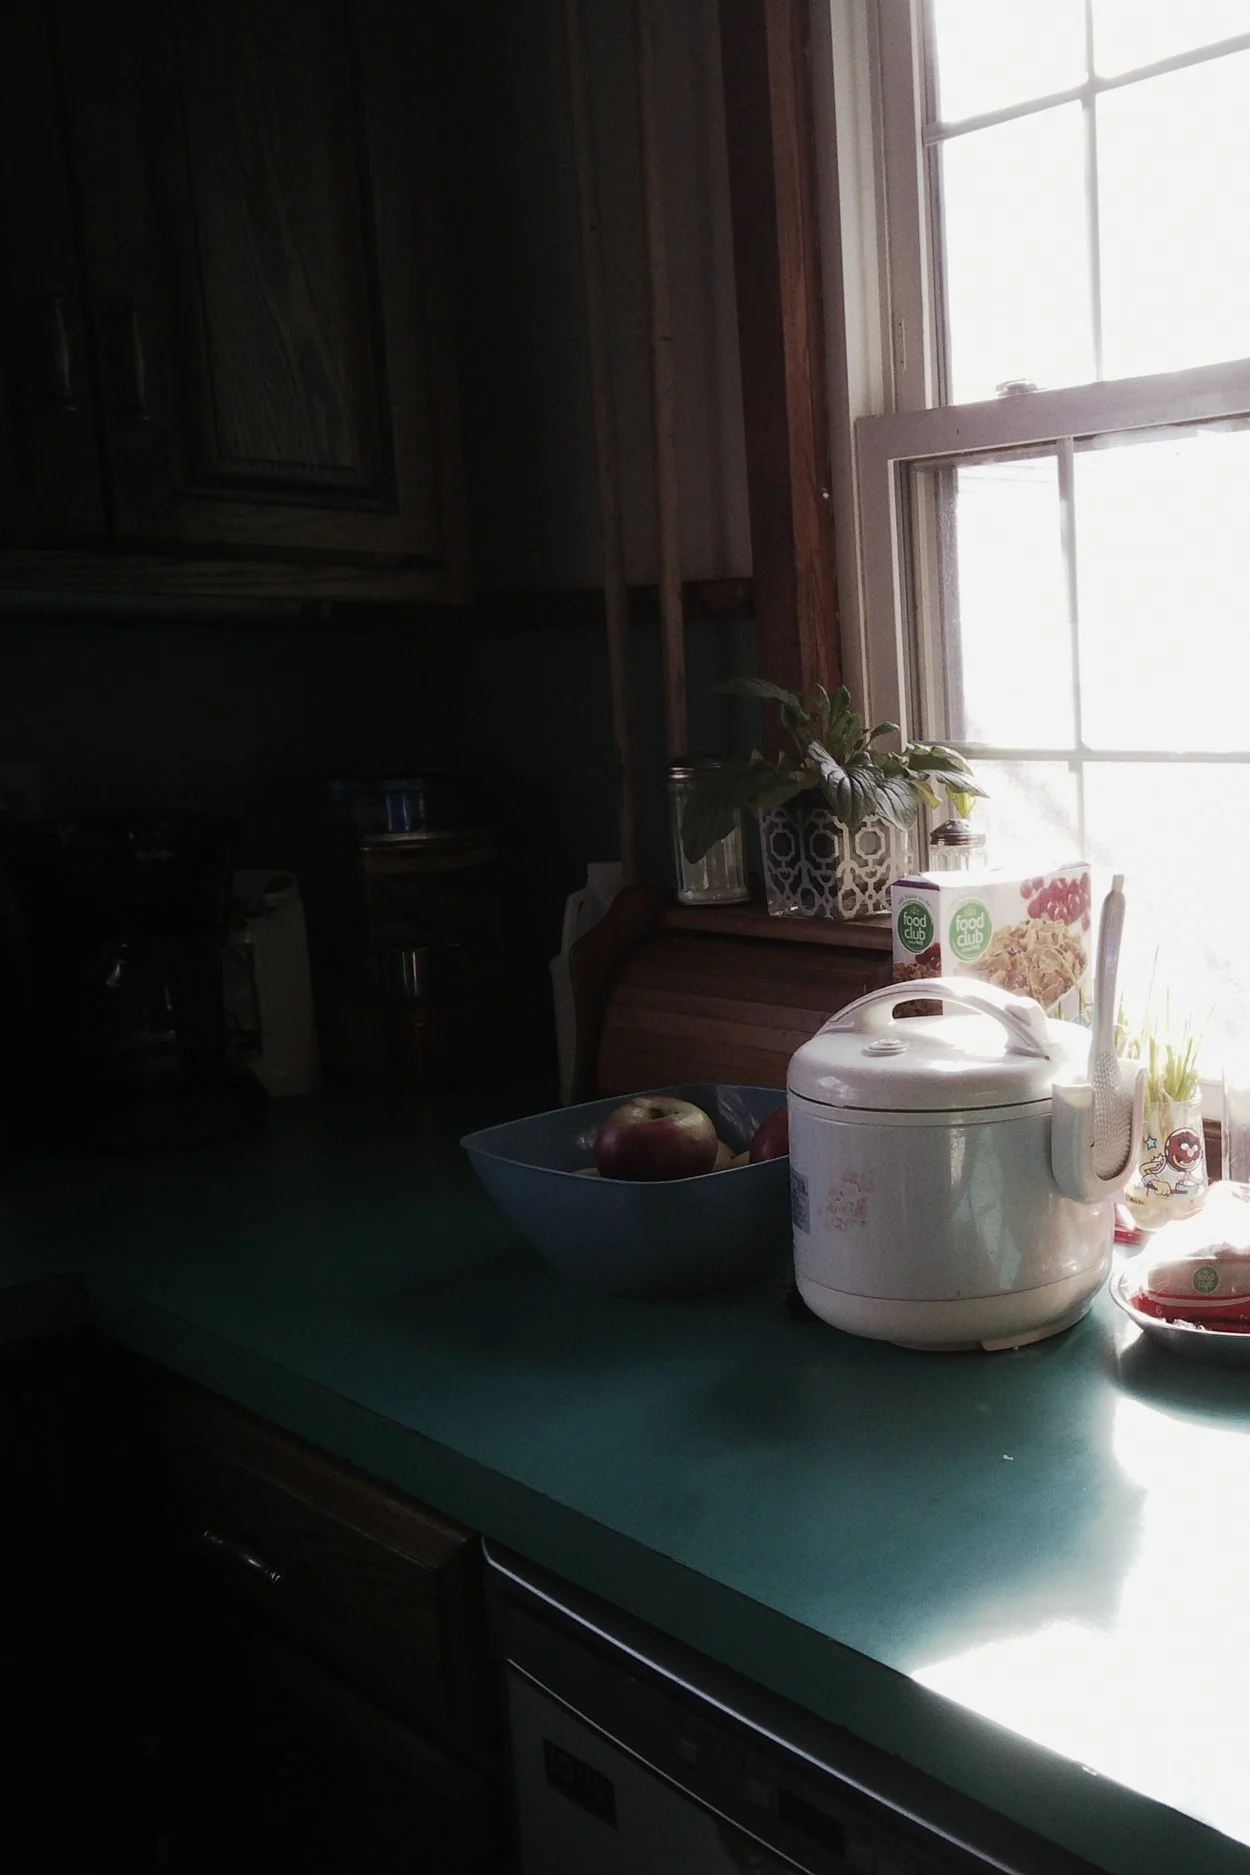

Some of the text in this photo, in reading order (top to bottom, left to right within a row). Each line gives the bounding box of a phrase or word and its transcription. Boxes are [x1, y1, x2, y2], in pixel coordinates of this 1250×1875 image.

[903, 911, 926, 928] food
[956, 911, 985, 932] food
[904, 926, 926, 940] club
[957, 928, 983, 946] club
